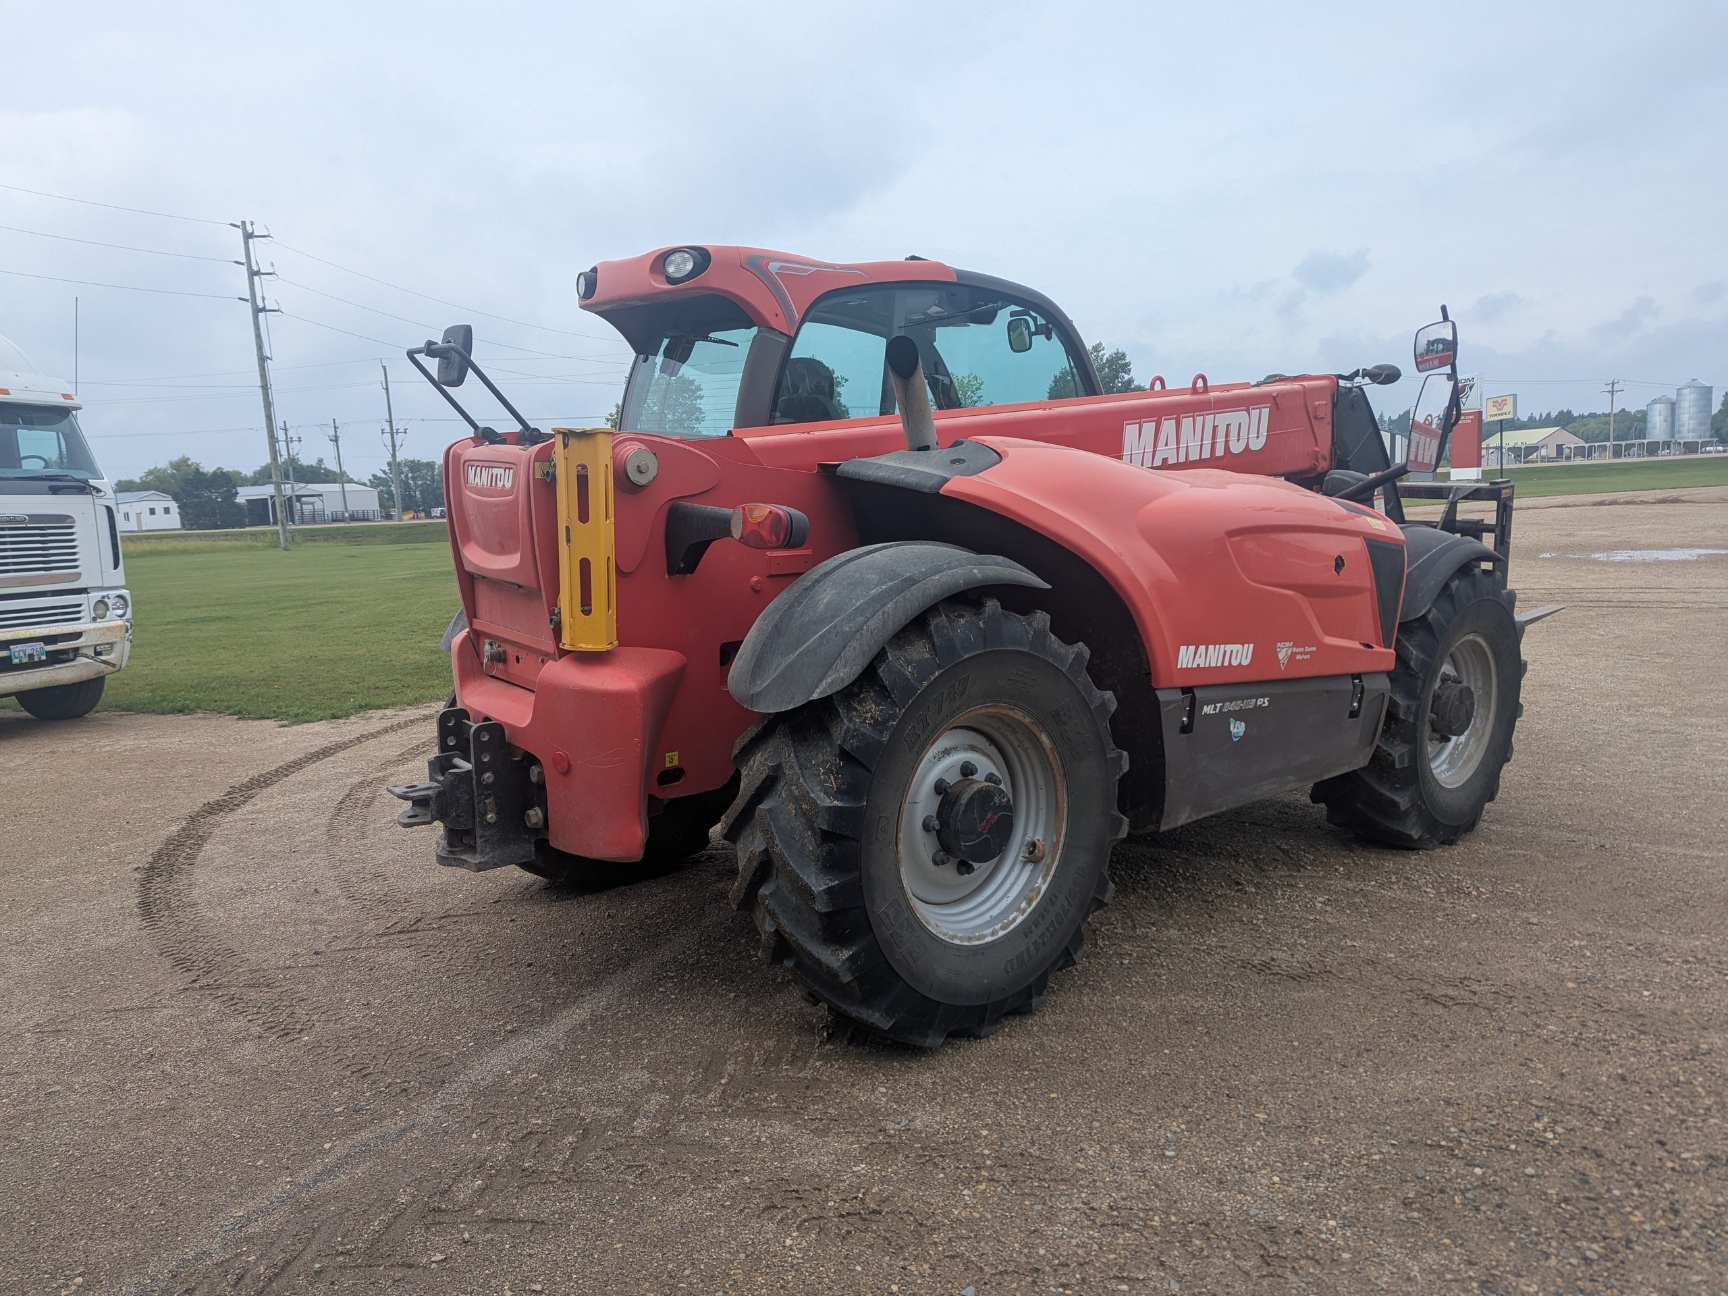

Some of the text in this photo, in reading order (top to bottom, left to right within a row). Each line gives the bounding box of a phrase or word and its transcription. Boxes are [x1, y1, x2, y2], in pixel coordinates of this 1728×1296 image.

[1122, 405, 1271, 468] MANITOU
[467, 465, 514, 489] MANITOU
[13, 648, 27, 659] CCV
[1177, 644, 1254, 669] MANITOU
[1201, 703, 1223, 715] MLT
[1257, 697, 1270, 707] PS
